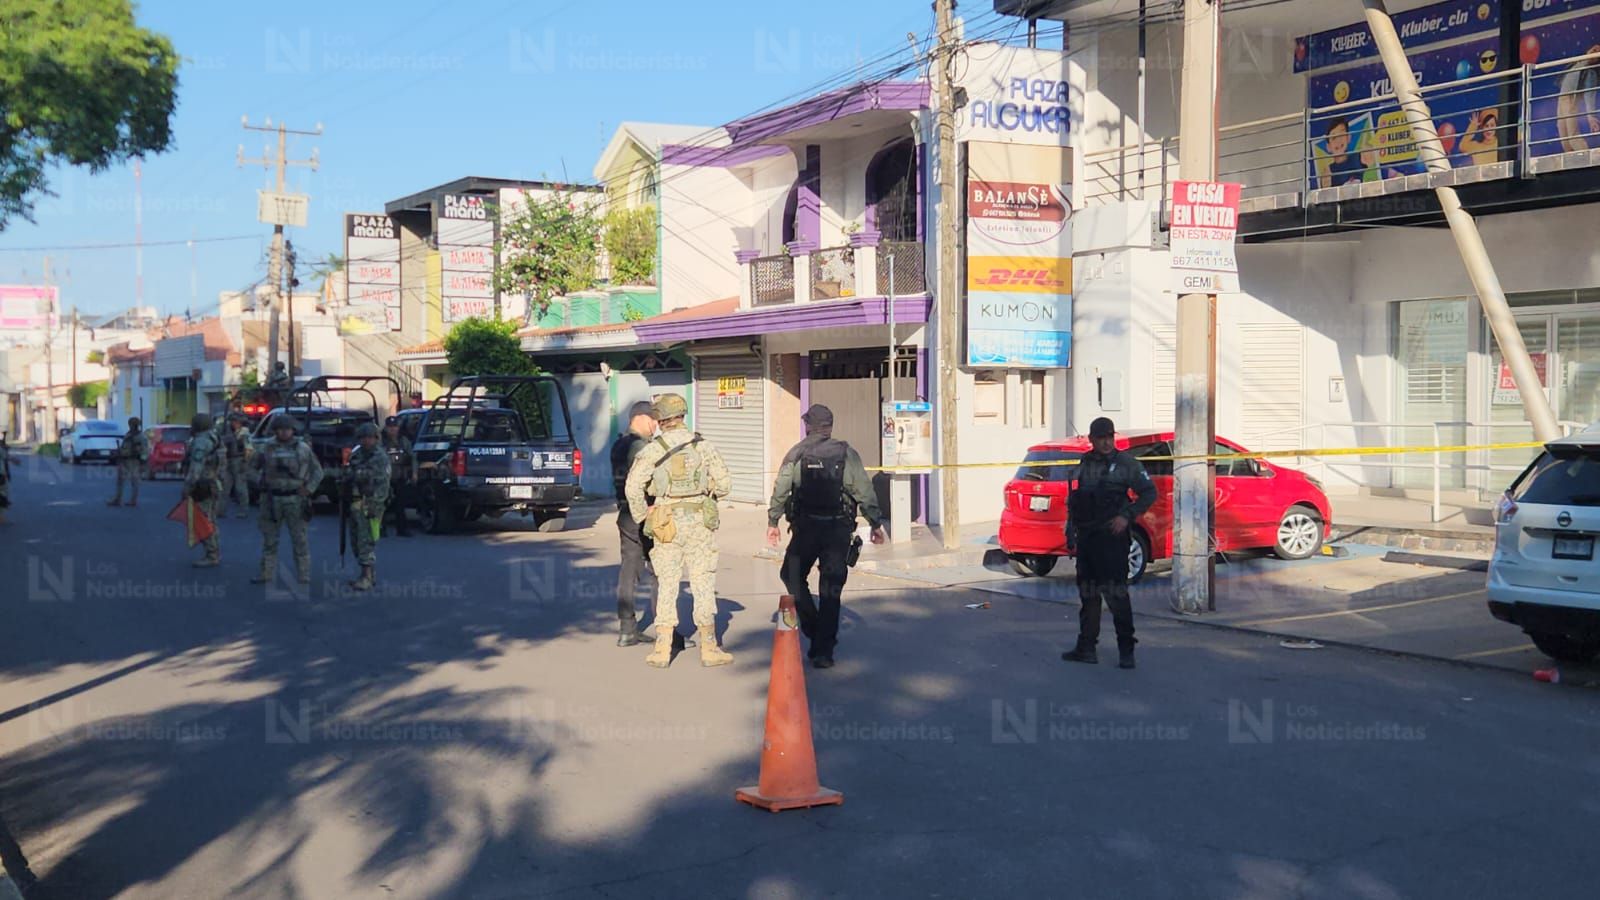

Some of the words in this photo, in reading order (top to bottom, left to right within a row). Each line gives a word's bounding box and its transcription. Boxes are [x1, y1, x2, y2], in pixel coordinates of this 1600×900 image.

[1401, 9, 1469, 38] Kluber_cln
[1330, 31, 1368, 54] KLUBER
[1010, 77, 1070, 103] PLAZA
[970, 100, 1071, 134] ALGUIER
[1187, 182, 1224, 204] CASA
[444, 195, 485, 208] PLAZA
[444, 207, 486, 219] maria
[1173, 204, 1192, 225] EN
[1194, 206, 1235, 228] VENTA
[353, 215, 393, 228] PLAZA
[353, 226, 394, 238] maria
[1172, 229, 1185, 240] EN
[1188, 229, 1208, 241] ESTA
[1212, 230, 1233, 242] ZONA
[1172, 256, 1192, 266] 667
[1194, 257, 1210, 267] 411
[983, 268, 1056, 287] DHL
[1183, 275, 1212, 289] GEMI
[981, 301, 1053, 322] KUMON
[548, 454, 567, 462] FGE
